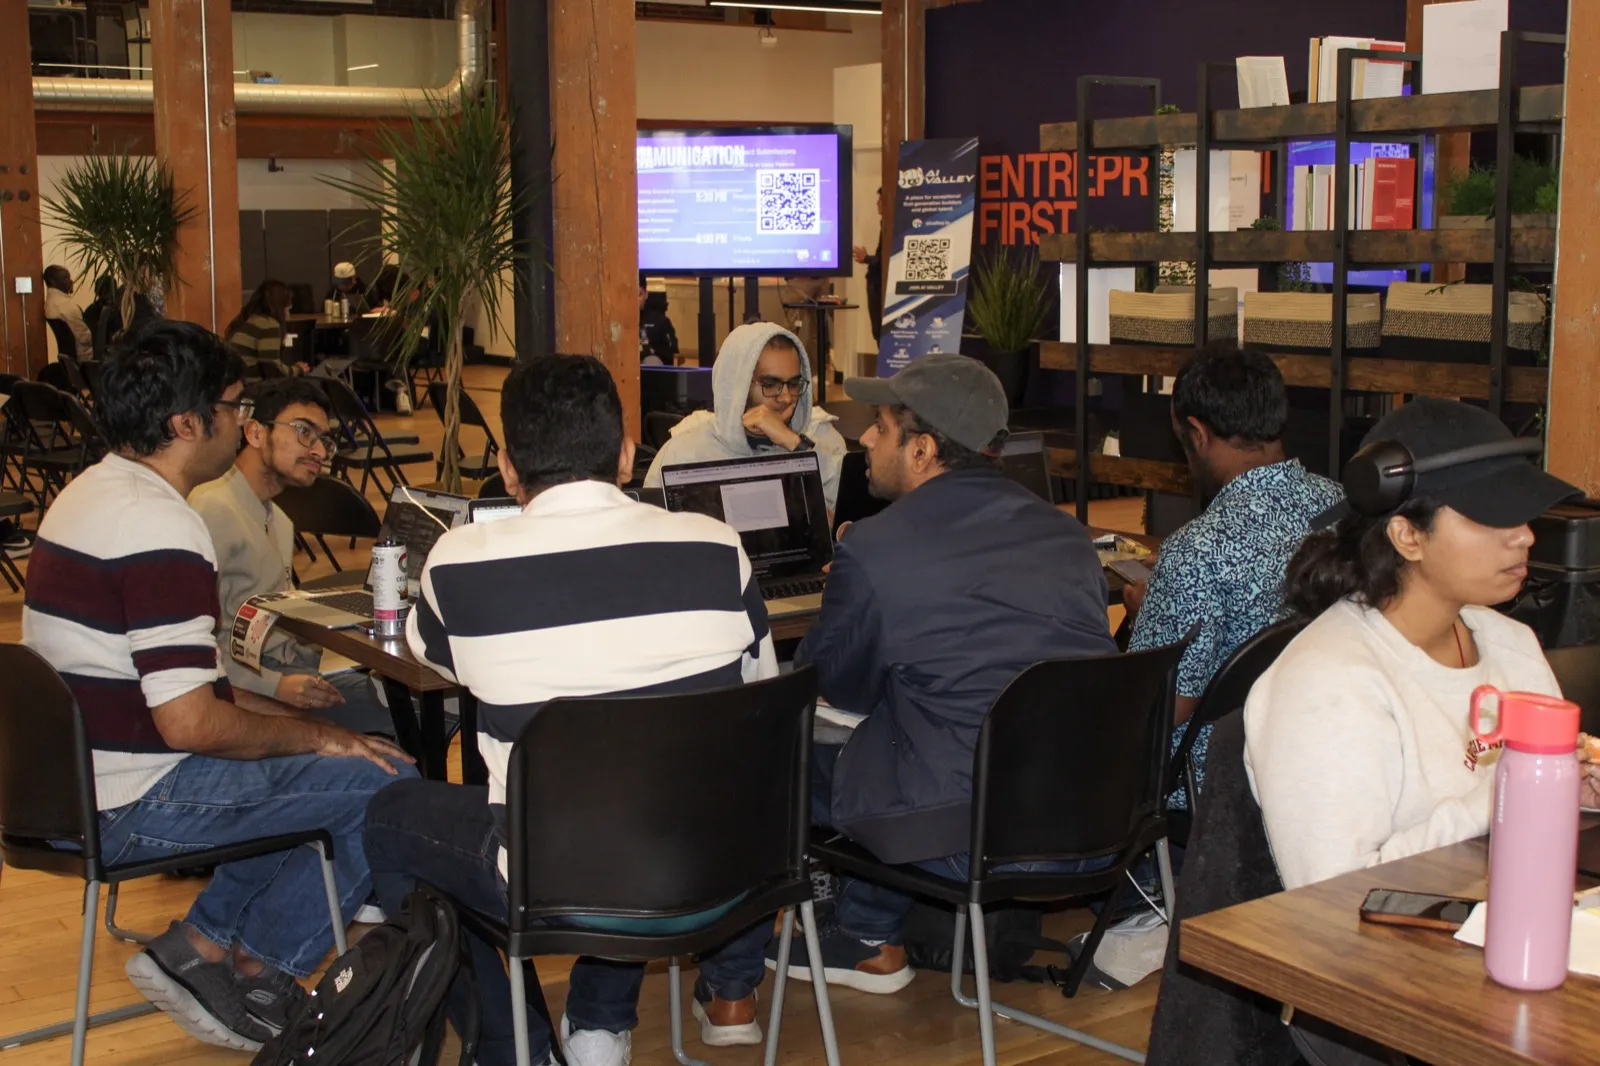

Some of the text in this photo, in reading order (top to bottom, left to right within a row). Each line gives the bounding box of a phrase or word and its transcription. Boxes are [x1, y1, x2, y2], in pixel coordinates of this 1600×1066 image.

[638, 145, 745, 168] MUNICATION
[925, 169, 940, 177] AI
[925, 174, 975, 185] VALLEY
[980, 200, 1078, 245] FIRST
